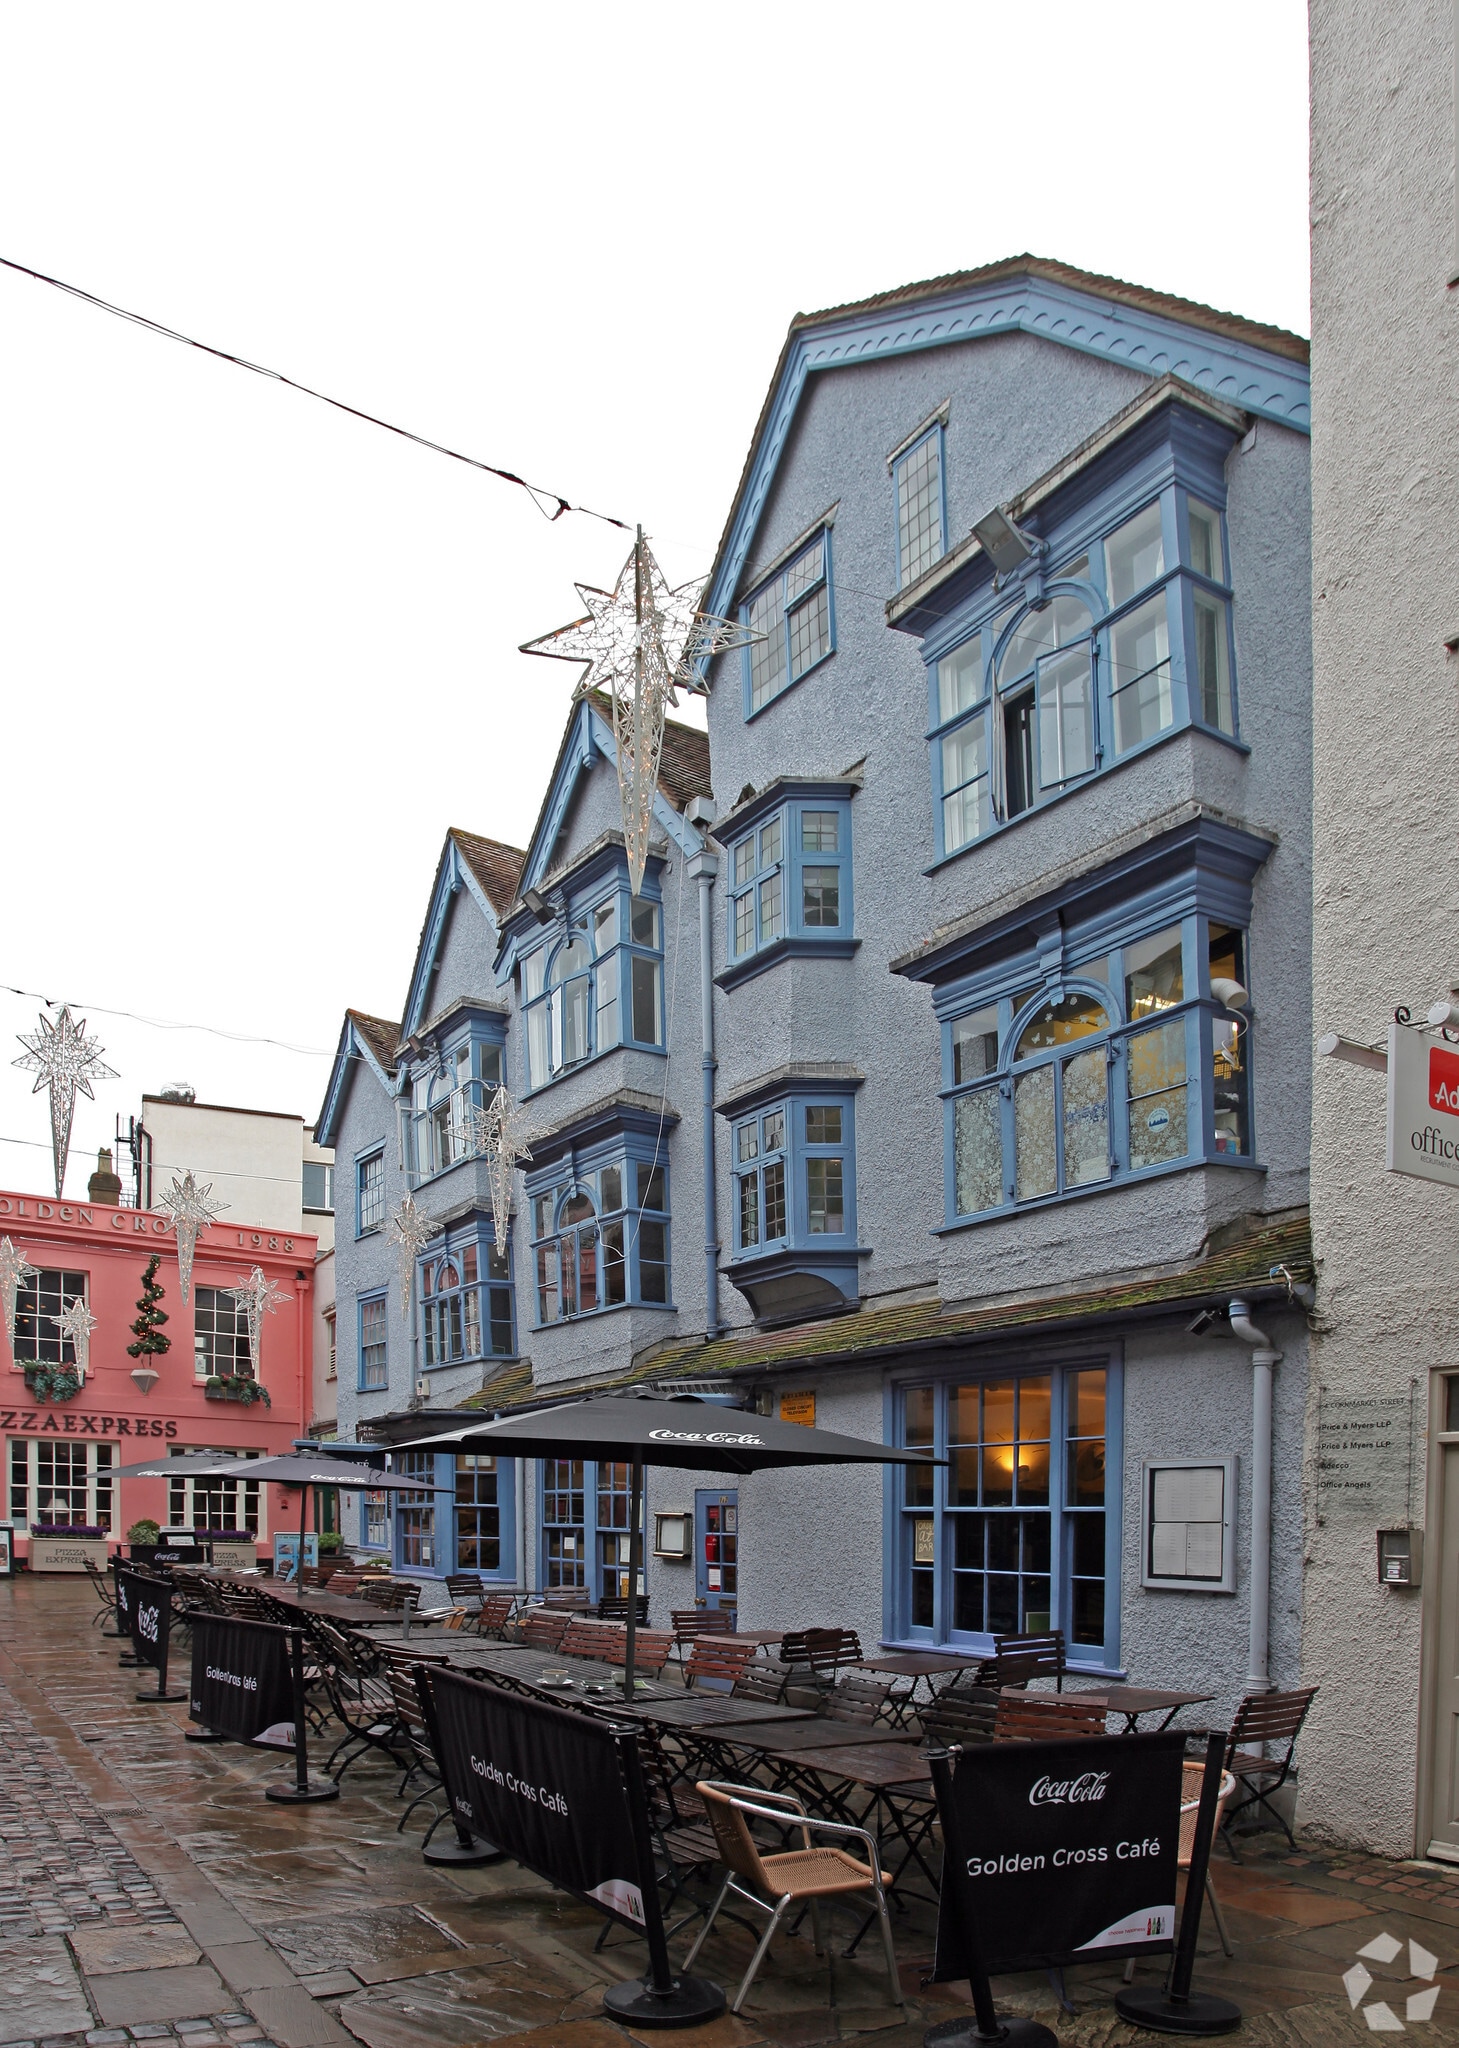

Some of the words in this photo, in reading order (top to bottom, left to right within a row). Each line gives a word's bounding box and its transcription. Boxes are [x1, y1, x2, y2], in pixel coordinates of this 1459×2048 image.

[112, 1213, 203, 1239] CRO
[238, 1232, 295, 1252] 1988
[1350, 1422, 1374, 1430] Myers
[1376, 1420, 1391, 1428] LLP
[648, 1429, 766, 1445] Coca-Cola
[1350, 1442, 1373, 1450] Myers
[1344, 1481, 1371, 1490] Angels
[918, 1542, 933, 1552] BAR
[214, 1559, 246, 1567] PRESS
[470, 1755, 504, 1787] Golden
[506, 1772, 537, 1802] Cross
[539, 1787, 568, 1816] Café
[1029, 1771, 1111, 1806] Coca-Cola
[967, 1853, 1045, 1876] Golden
[1052, 1847, 1108, 1866] Cross
[1116, 1838, 1161, 1859] Café
